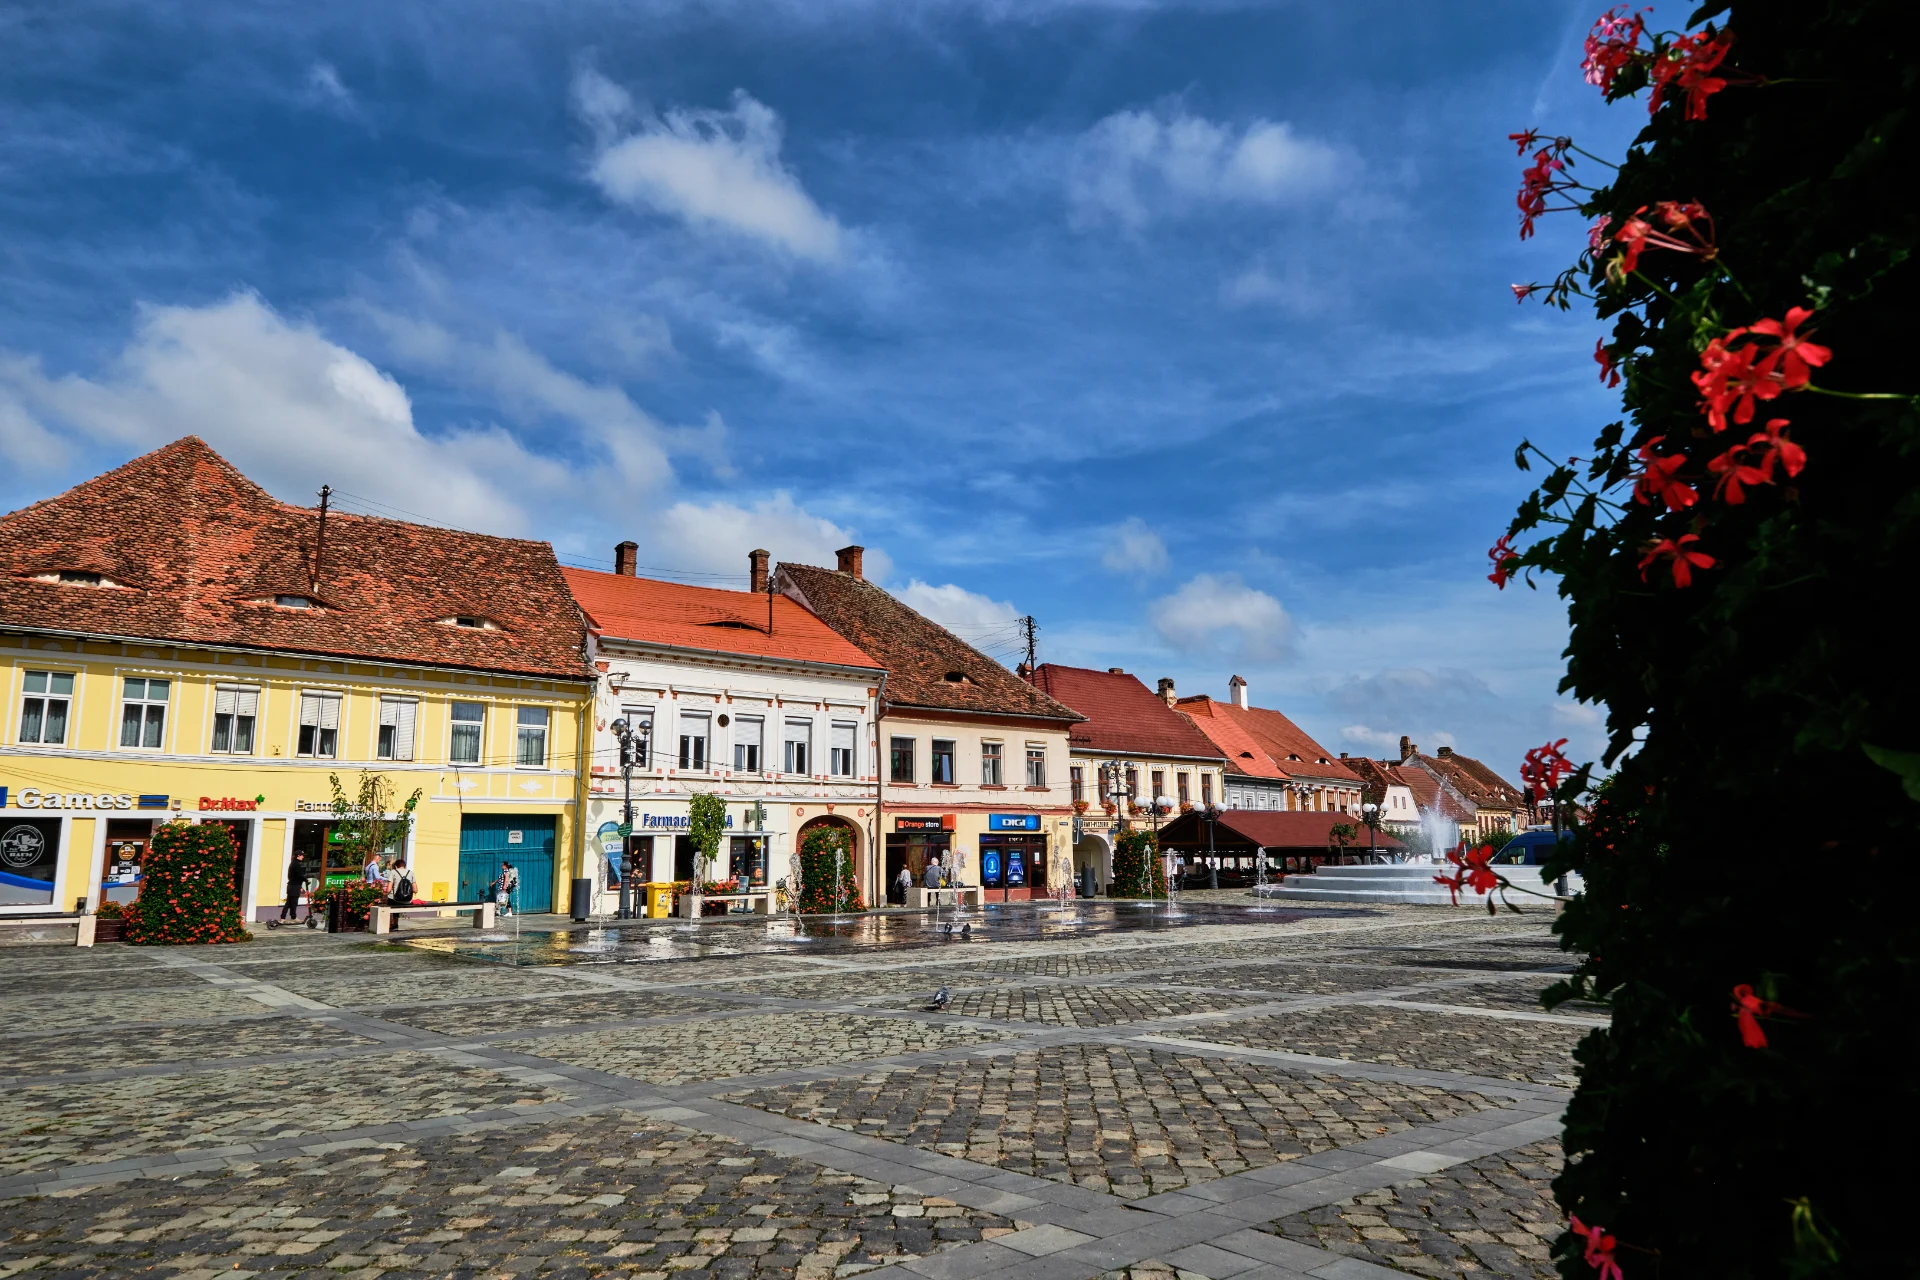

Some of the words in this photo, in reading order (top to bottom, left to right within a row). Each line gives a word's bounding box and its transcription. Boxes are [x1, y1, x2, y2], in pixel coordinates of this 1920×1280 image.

[16, 787, 132, 809] Games
[199, 796, 258, 811] Dr.Max
[905, 820, 924, 829] Orange
[1002, 818, 1026, 827] DIGI
